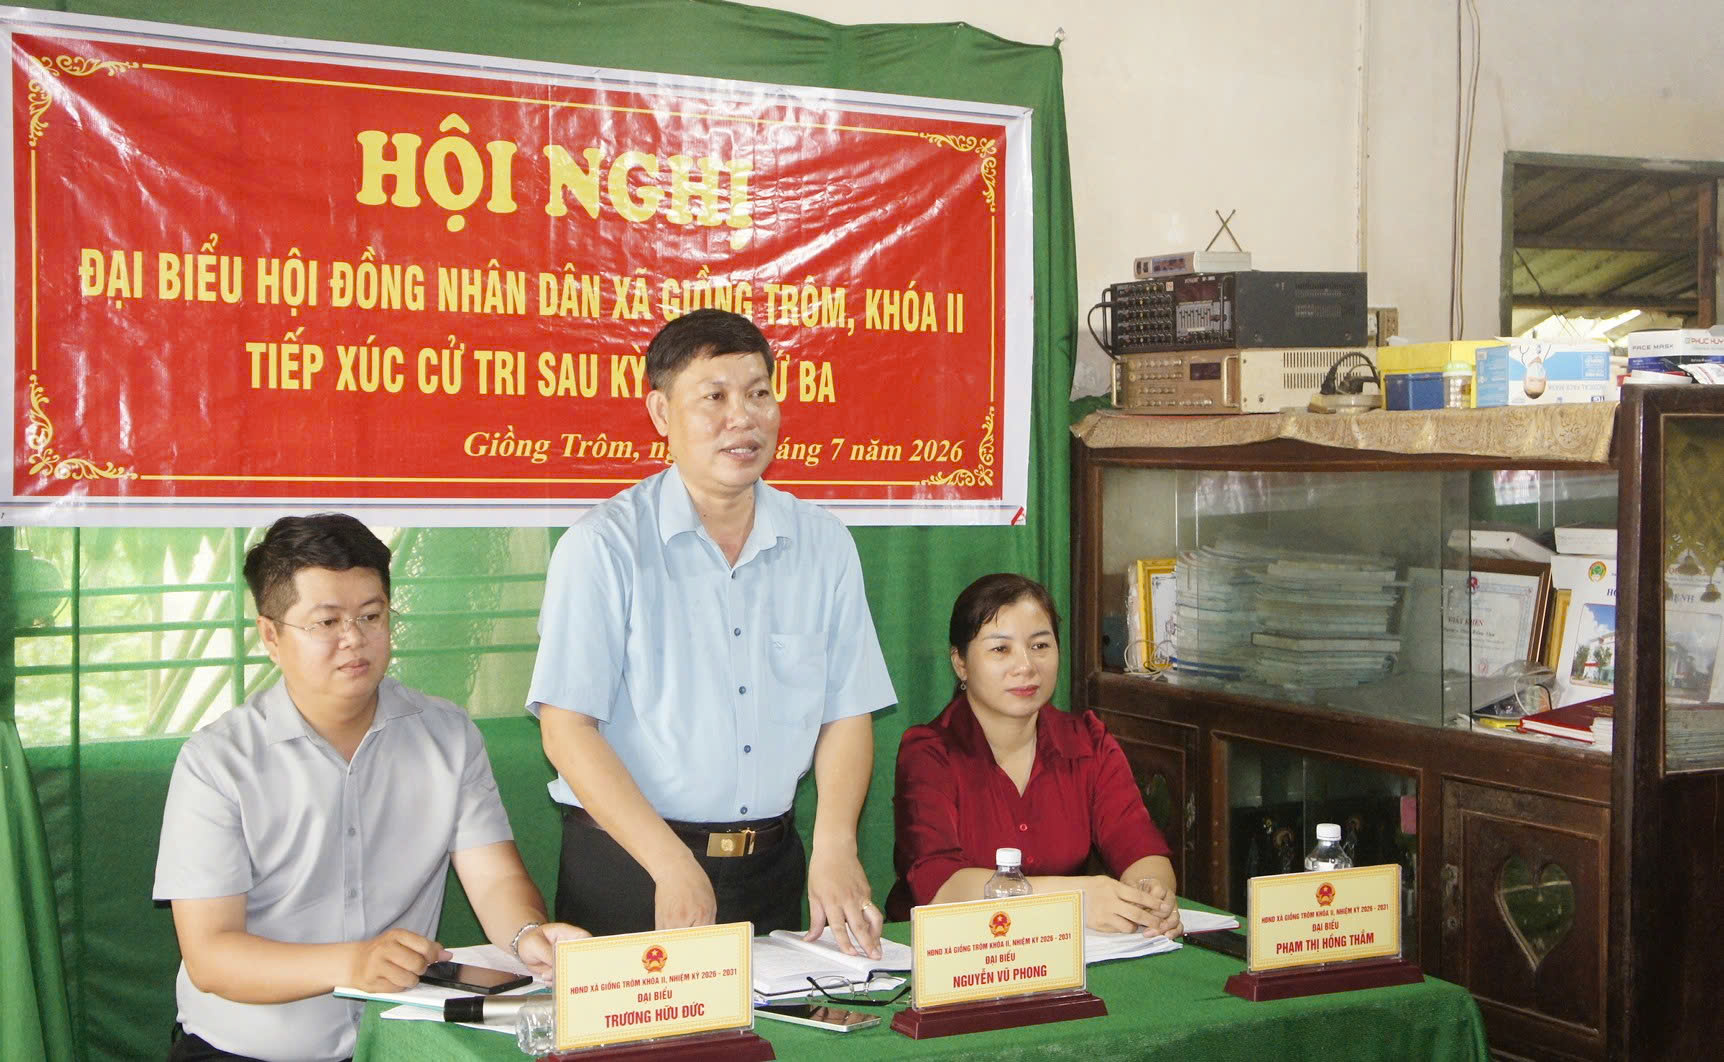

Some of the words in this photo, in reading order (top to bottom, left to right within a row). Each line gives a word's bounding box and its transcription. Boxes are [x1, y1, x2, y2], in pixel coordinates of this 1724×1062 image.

[356, 113, 518, 232] HỘI
[543, 145, 753, 250] NGHỊ
[79, 247, 143, 309] ĐẠI
[158, 233, 241, 303] BIỂU
[257, 247, 317, 316] HỘI
[330, 246, 425, 310] ĐỒNG
[438, 259, 525, 315] NHÂN
[539, 263, 600, 319] DÂN
[612, 267, 654, 320] XÃ
[662, 265, 753, 322] GIỒNG
[764, 277, 855, 336] TRÔM,
[865, 281, 939, 333] KHÓA
[947, 293, 964, 334] II
[246, 327, 324, 390] TIẾP
[336, 335, 404, 393] XÚC
[417, 335, 464, 395] CỬ
[474, 351, 525, 395] TRI
[538, 352, 598, 398] SAU
[611, 345, 647, 398] KỲ
[799, 361, 836, 403] BA
[463, 424, 550, 463] Giồng
[561, 433, 639, 464] Trôm,
[776, 438, 822, 466] áng
[831, 438, 845, 460] 7
[850, 439, 902, 461] năm
[909, 439, 963, 462] 2026
[1059, 932, 1072, 941] 2031
[1312, 922, 1322, 933] ĐẠI
[1325, 919, 1339, 930] BIỂU
[1276, 940, 1303, 955] PHẠM
[1306, 938, 1319, 952] THỊ
[1322, 933, 1347, 949] HỒNG
[985, 954, 997, 966] ĐẠI
[999, 950, 1016, 962] BIỂU
[701, 970, 716, 979] 2026
[722, 968, 737, 977] 2031
[953, 968, 994, 988] NGUYỄN
[997, 967, 1010, 983] VŨ
[1013, 965, 1047, 980] PHONG
[638, 993, 651, 1005] ĐẠI
[654, 986, 673, 1001] BIỂU
[604, 1009, 651, 1028] TRƯƠNG
[655, 1005, 679, 1022] HỮU
[682, 1001, 705, 1019] ĐỨC
